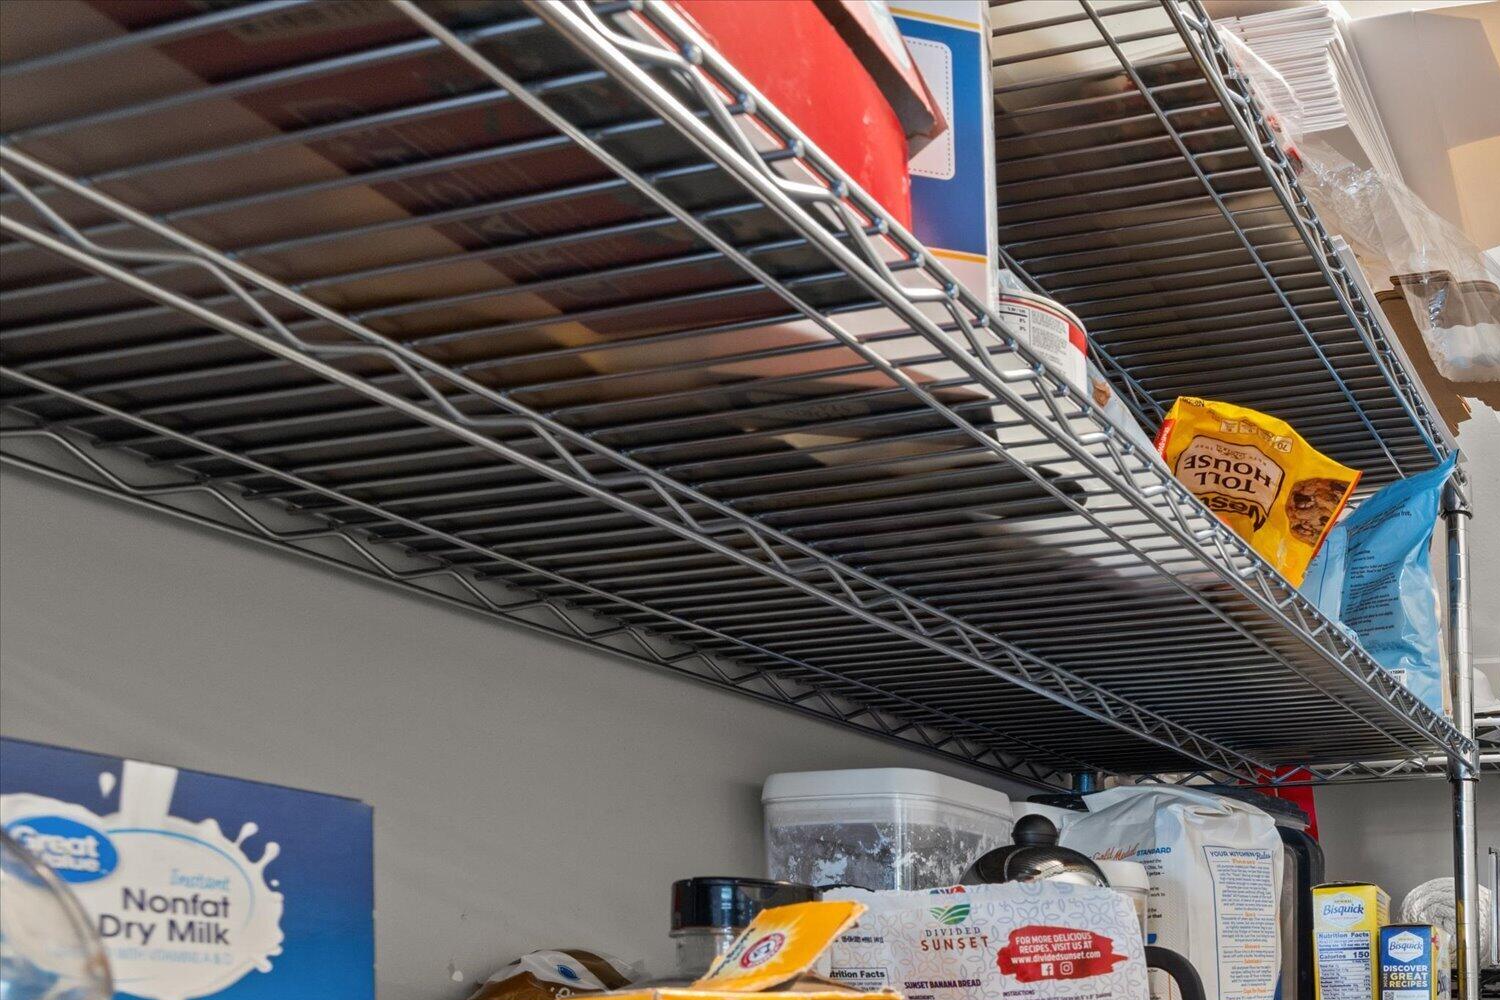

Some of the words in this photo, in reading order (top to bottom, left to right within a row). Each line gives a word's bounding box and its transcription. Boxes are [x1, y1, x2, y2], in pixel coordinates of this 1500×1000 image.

[1184, 453, 1272, 488] HOUSE
[1194, 472, 1256, 494] TOLL
[8, 825, 99, 850] Great
[1137, 847, 1171, 856] STANDARD
[1256, 851, 1271, 860] Rules
[122, 887, 231, 919] Nonfat
[1323, 904, 1364, 916] Bisquick
[100, 914, 156, 945] Dry
[168, 919, 230, 945] Milk
[926, 927, 981, 937] DIVIDED
[921, 936, 989, 951] SUNSET
[1015, 936, 1031, 945] FOR
[1032, 935, 1052, 943] MORE
[1053, 932, 1091, 942] DELICIOUS
[1019, 944, 1050, 954] RECIPES,
[1052, 943, 1071, 951] VISIT
[1072, 942, 1082, 950] US
[1082, 941, 1092, 949] AT
[1389, 941, 1423, 951] Bisquick
[1011, 951, 1101, 965] www.dividedsunset.com
[860, 971, 885, 979] Facts
[1390, 972, 1428, 980] GREAT
[904, 981, 929, 989] SUNSET
[929, 980, 957, 988] BANANA
[958, 979, 981, 987] BREAD
